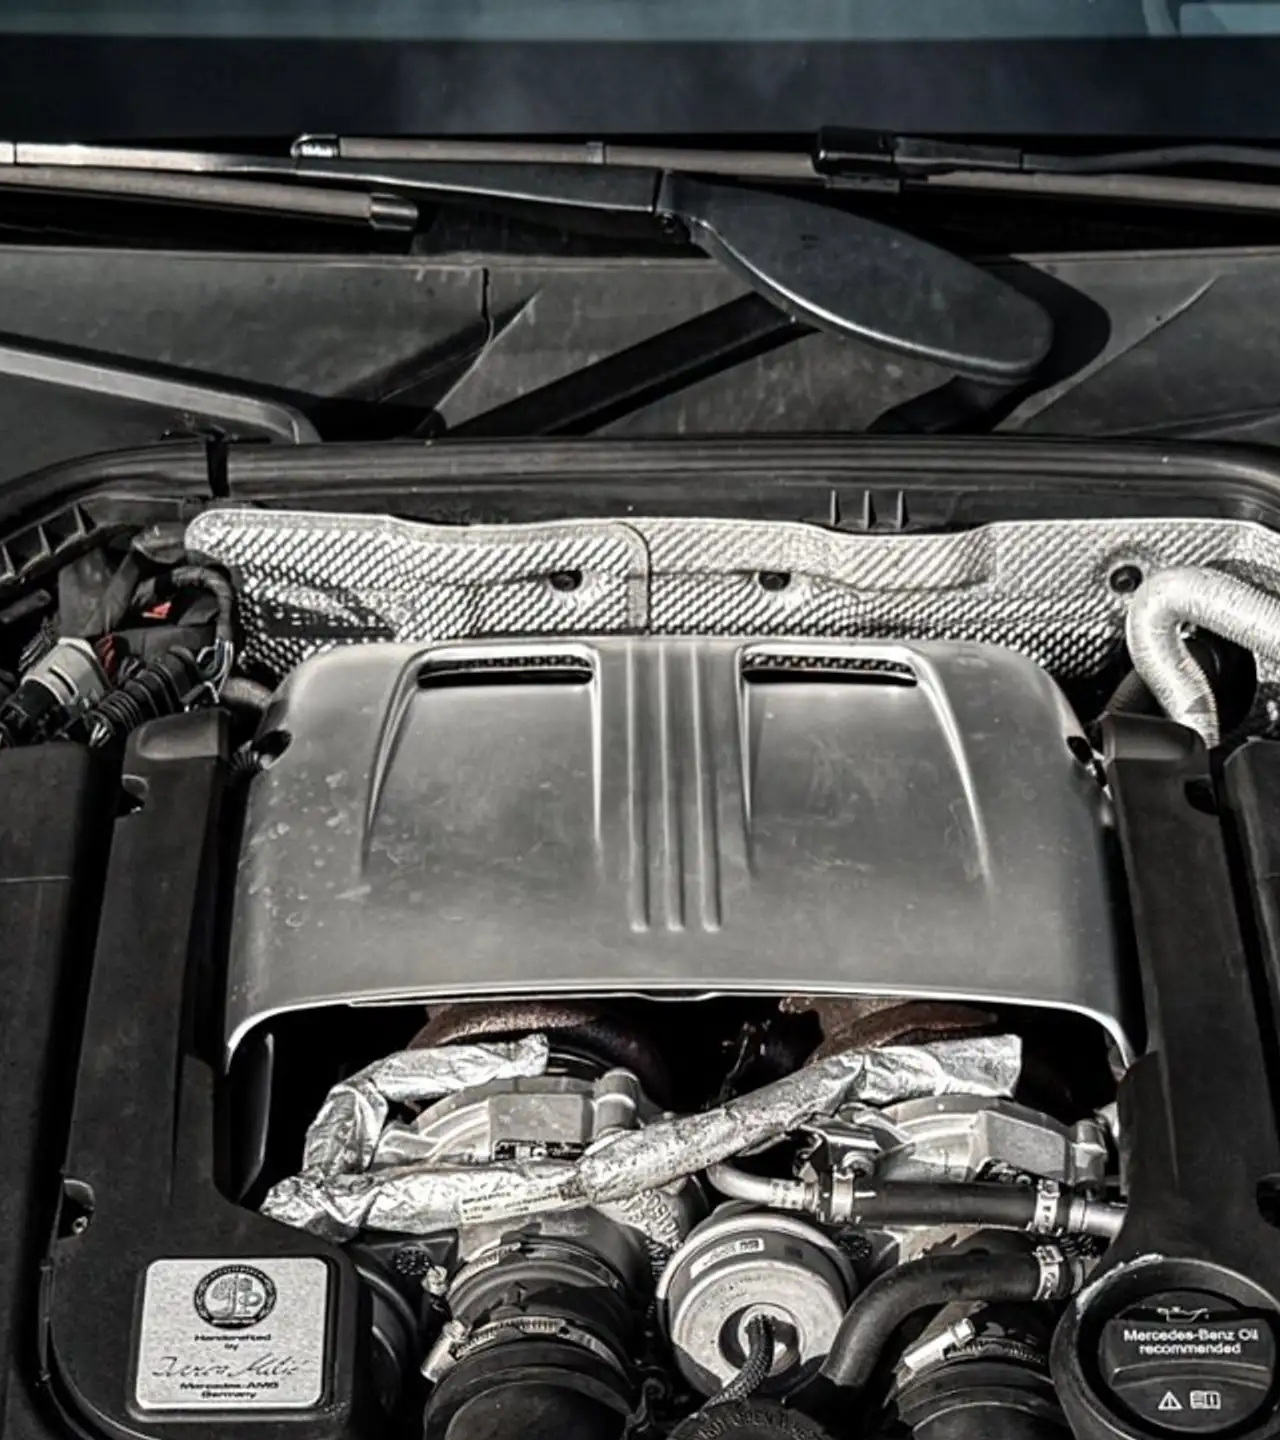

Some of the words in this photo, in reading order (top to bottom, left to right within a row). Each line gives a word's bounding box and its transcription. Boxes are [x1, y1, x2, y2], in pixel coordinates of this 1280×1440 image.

[194, 1333, 271, 1342] Handcrafted
[1123, 1328, 1235, 1342] Mercedes-Benz
[1238, 1328, 1260, 1341] Oil
[1138, 1342, 1242, 1355] recommended
[180, 1381, 279, 1390] Mercedes-AMG
[201, 1390, 257, 1399] Germany
